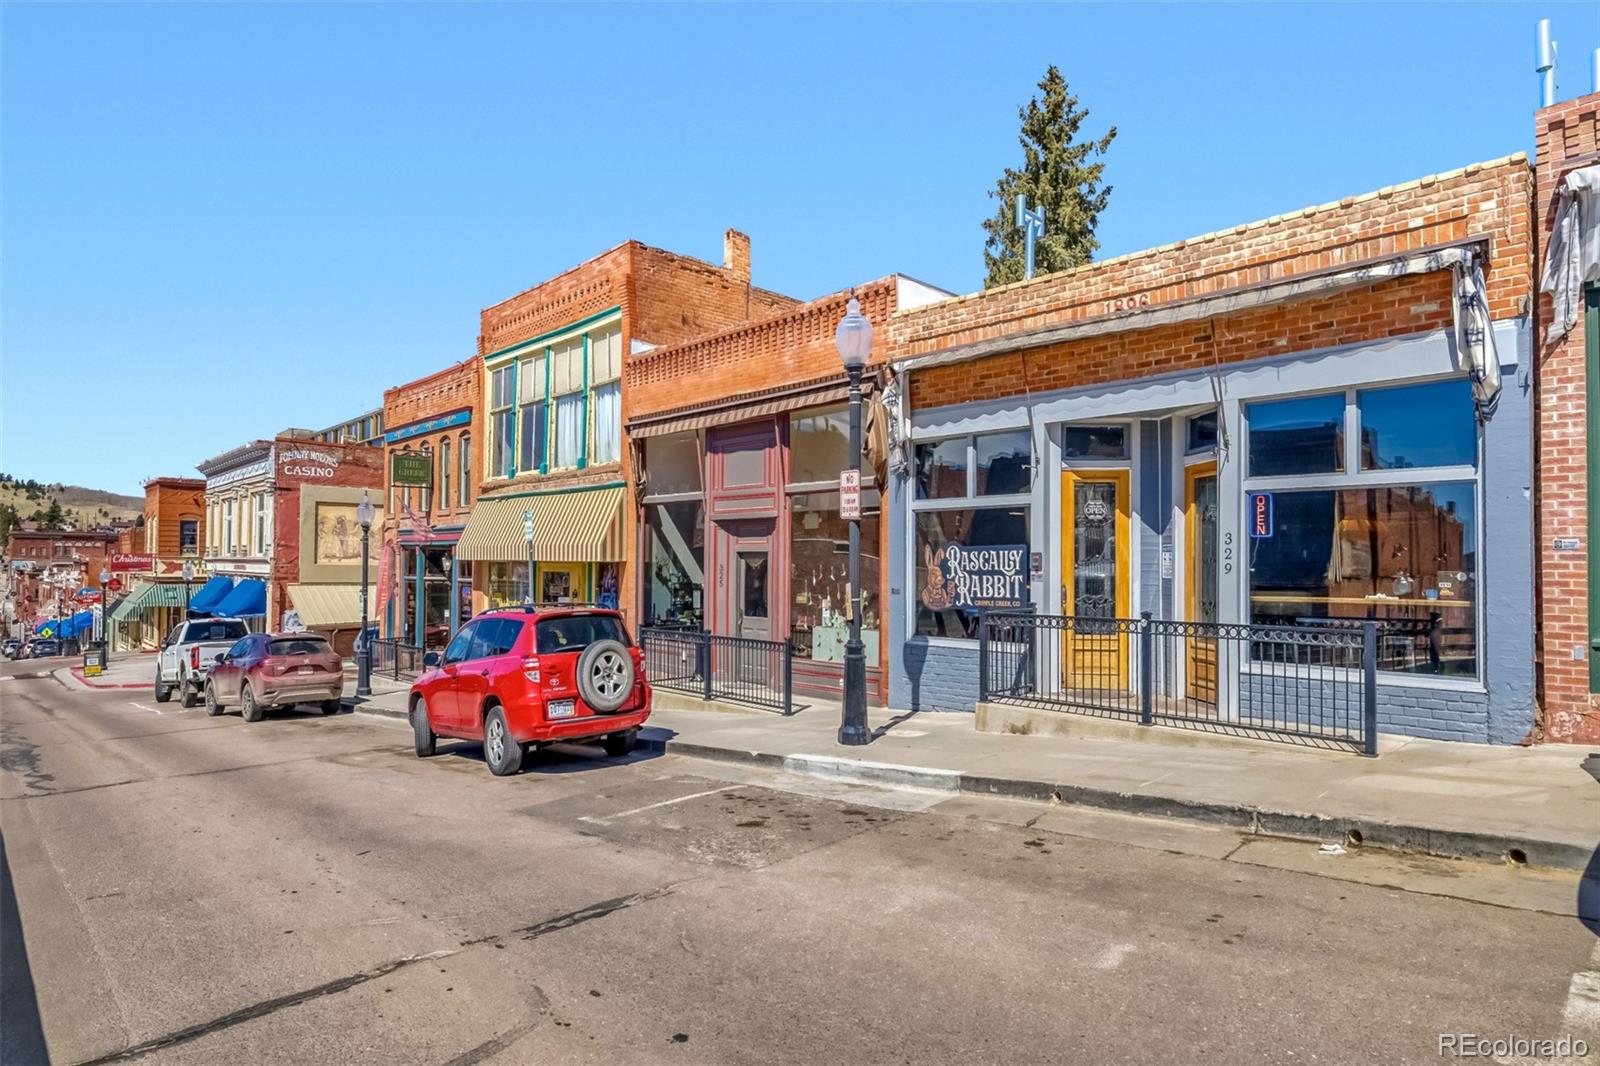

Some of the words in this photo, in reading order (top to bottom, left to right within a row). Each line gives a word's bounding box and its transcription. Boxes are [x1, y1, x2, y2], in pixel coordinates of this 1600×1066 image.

[284, 465, 334, 478] CASINO
[1085, 506, 1105, 514] OPEN
[1257, 495, 1265, 535] OPEN
[112, 554, 152, 564] Christmas
[1224, 532, 1233, 575] 329
[955, 571, 1023, 606] RABBIT
